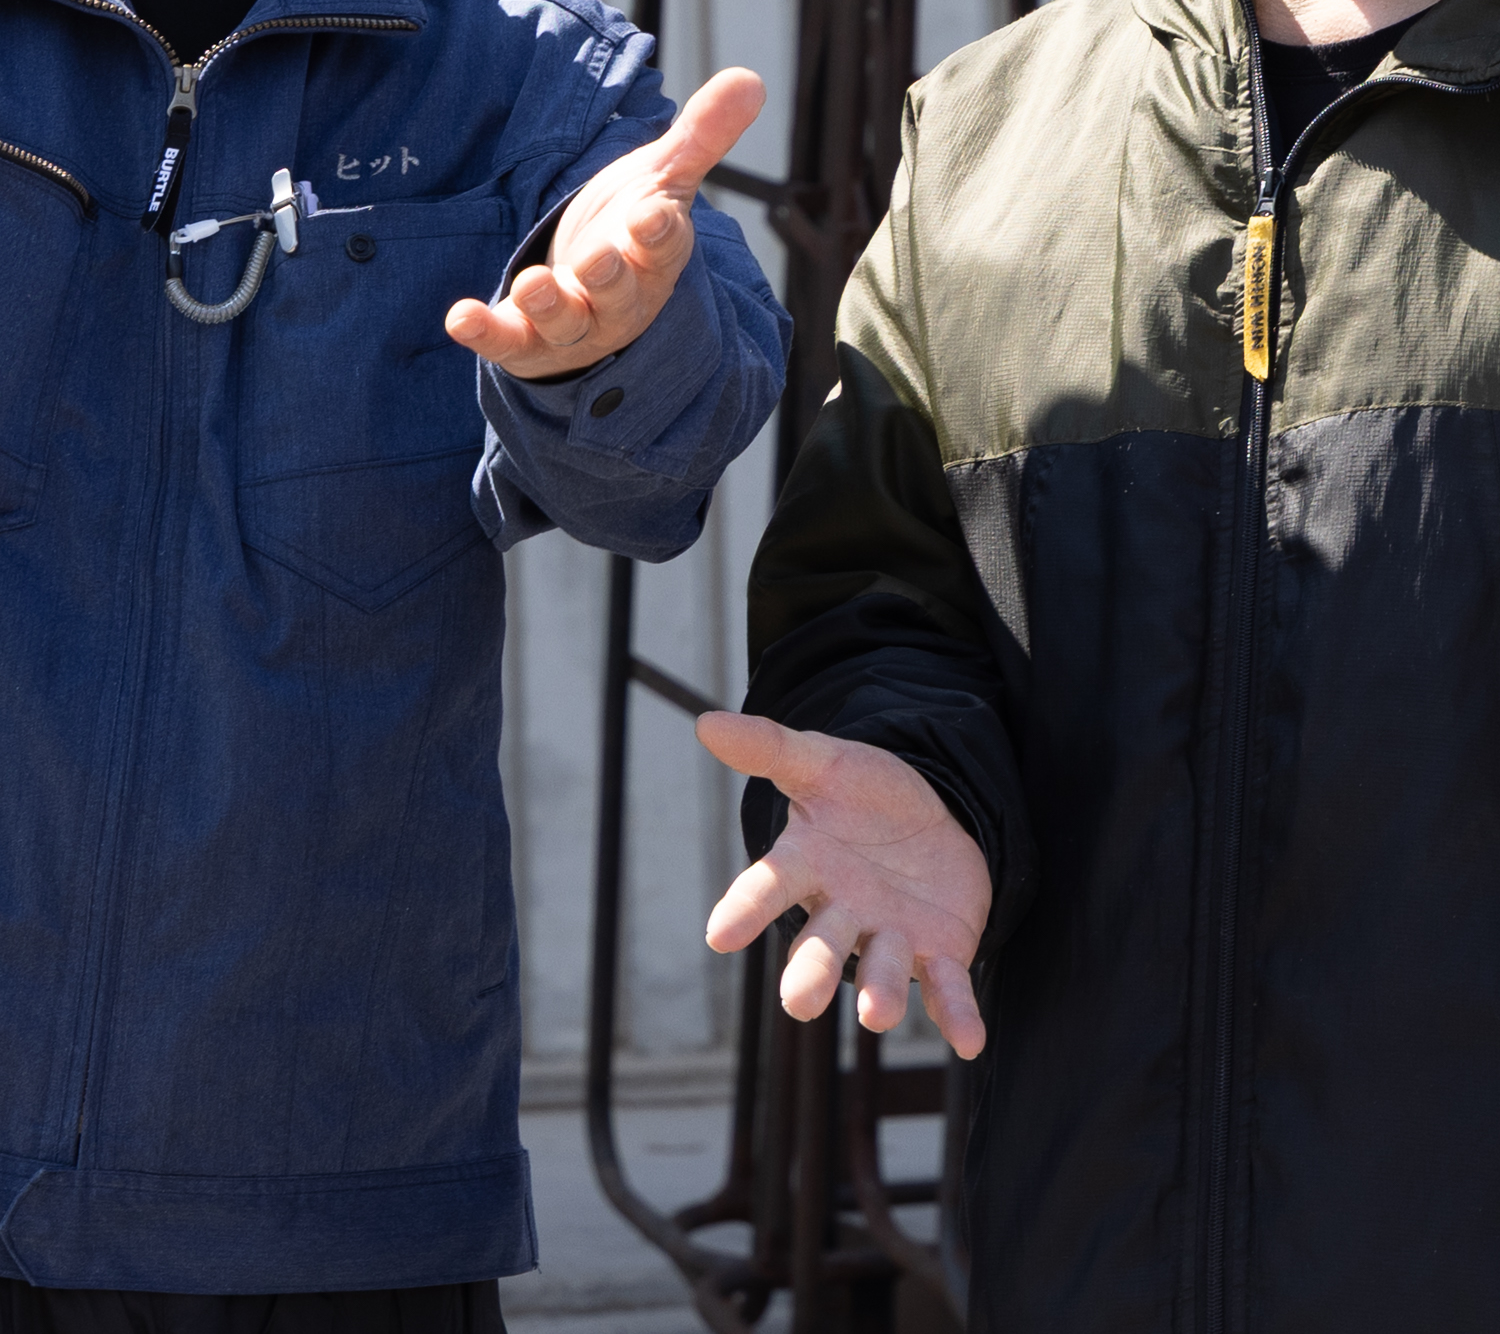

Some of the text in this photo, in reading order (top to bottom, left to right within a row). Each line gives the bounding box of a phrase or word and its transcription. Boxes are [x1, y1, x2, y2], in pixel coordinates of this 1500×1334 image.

[148, 147, 180, 213] BURTLE
[336, 145, 421, 181] ヒット
